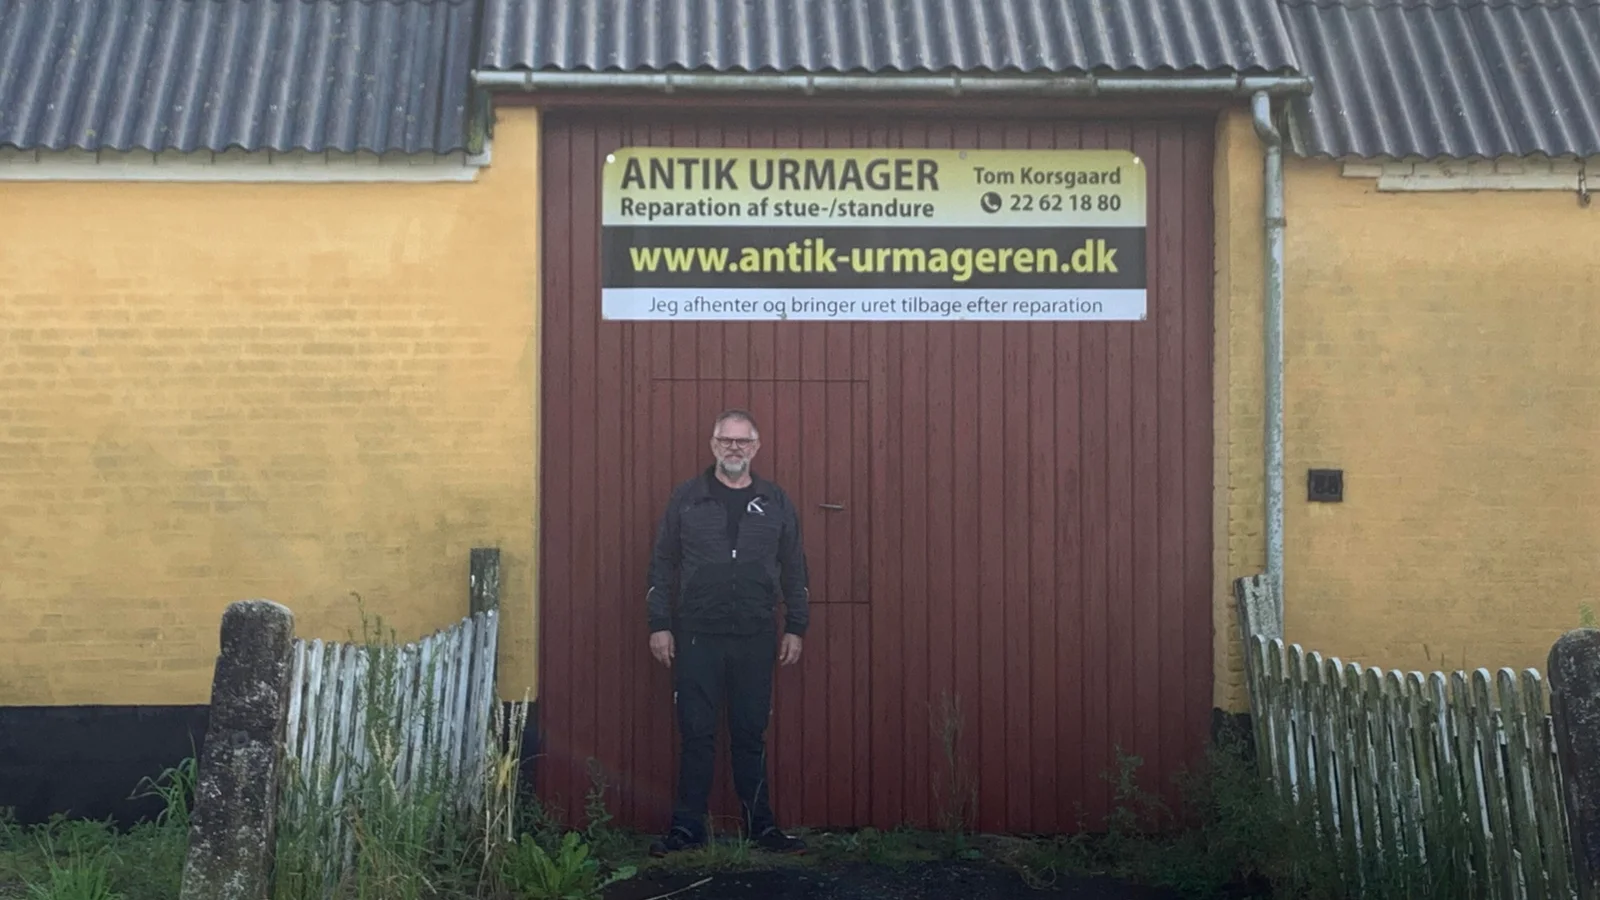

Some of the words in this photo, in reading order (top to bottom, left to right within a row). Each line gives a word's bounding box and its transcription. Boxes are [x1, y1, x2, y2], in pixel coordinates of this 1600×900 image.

[620, 157, 739, 190] ANTIK
[750, 157, 940, 191] URMAGER
[973, 166, 1015, 185] Tom
[1020, 166, 1122, 189] Korsgaard
[620, 196, 741, 221] Reparation
[747, 196, 769, 217] af
[773, 197, 935, 218] stue-/standure
[1010, 194, 1034, 212] 22
[1038, 194, 1063, 212] 62
[1070, 194, 1093, 212] 18
[1097, 194, 1122, 212] 80
[629, 238, 1119, 282] www.antik-urmageren.dk
[648, 296, 678, 317] Jeg
[683, 296, 759, 313] afhenter
[763, 301, 787, 318] og
[791, 296, 856, 317] bringer
[861, 299, 897, 313] uret
[901, 296, 963, 317] tilbage
[966, 296, 1009, 313] efter
[1012, 298, 1103, 317] reparation
